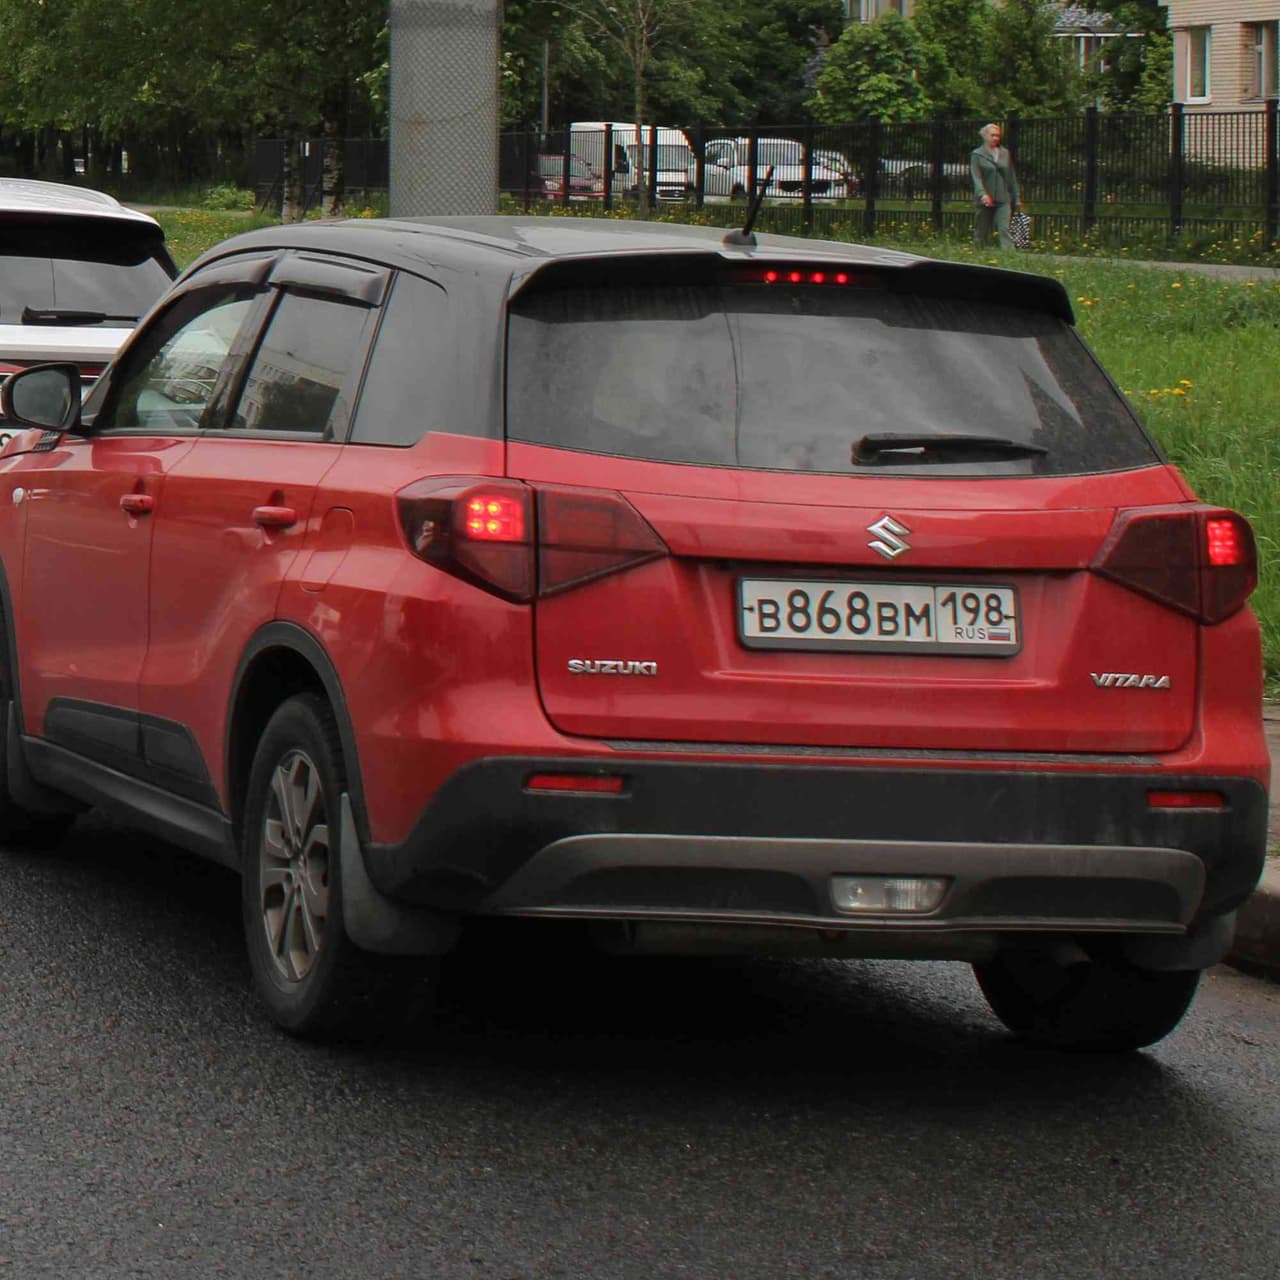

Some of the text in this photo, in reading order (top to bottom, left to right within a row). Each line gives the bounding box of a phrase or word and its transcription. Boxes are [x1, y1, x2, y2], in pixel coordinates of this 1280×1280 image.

[941, 591, 1003, 626] 198
[955, 627, 986, 639] RUS
[568, 659, 657, 674] SUZUKI
[1090, 673, 1170, 688] VITARA
